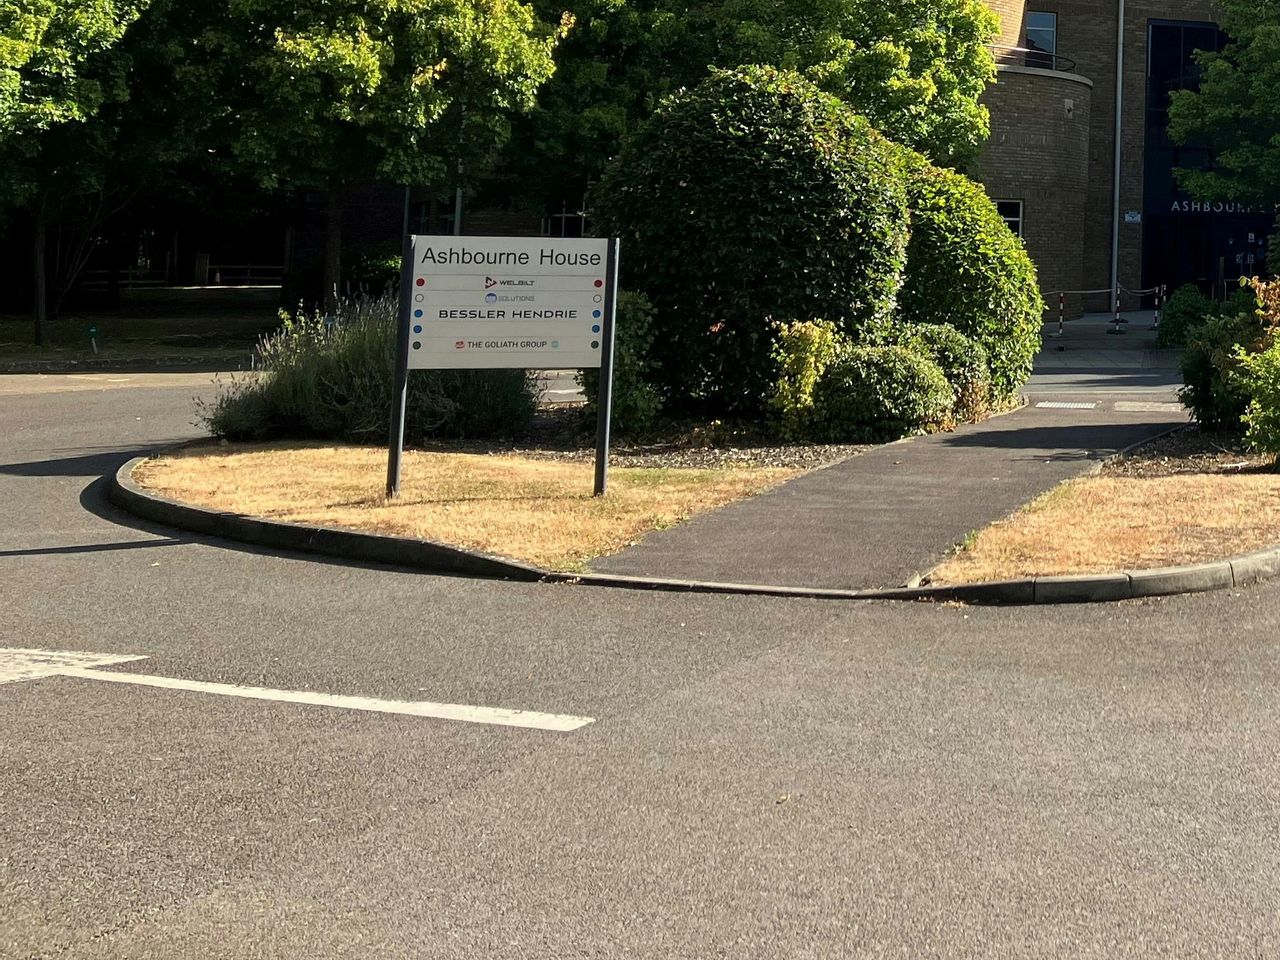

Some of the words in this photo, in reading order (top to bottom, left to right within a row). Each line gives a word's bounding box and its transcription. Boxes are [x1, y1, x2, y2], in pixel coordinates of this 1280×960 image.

[421, 247, 530, 265] Ashbourne
[540, 249, 601, 266] House
[439, 310, 506, 319] BESSLER
[512, 310, 578, 319] HENDRIE
[467, 341, 483, 349] THE
[484, 341, 519, 349] GOLIATH
[520, 341, 548, 349] GROUP
